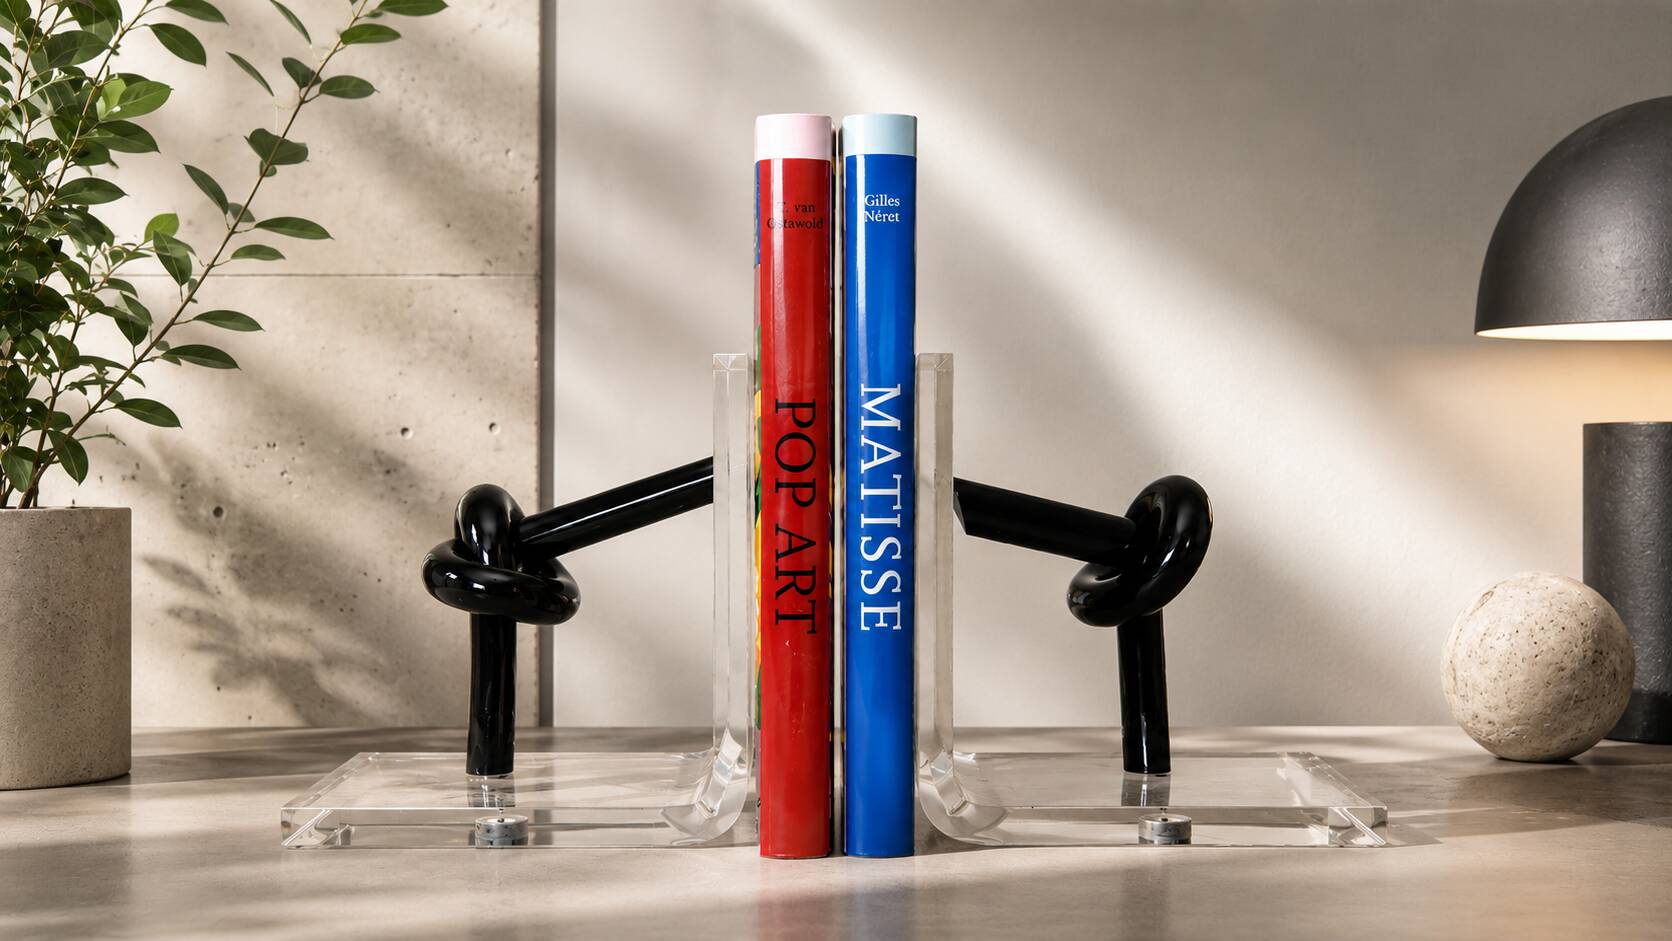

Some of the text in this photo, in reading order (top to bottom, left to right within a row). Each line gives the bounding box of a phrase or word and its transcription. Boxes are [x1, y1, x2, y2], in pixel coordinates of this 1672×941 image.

[864, 194, 900, 207] Gilles
[794, 204, 816, 213] van
[864, 211, 900, 223] Néret
[860, 384, 902, 632] MATISSE
[775, 399, 816, 635] POP ART
